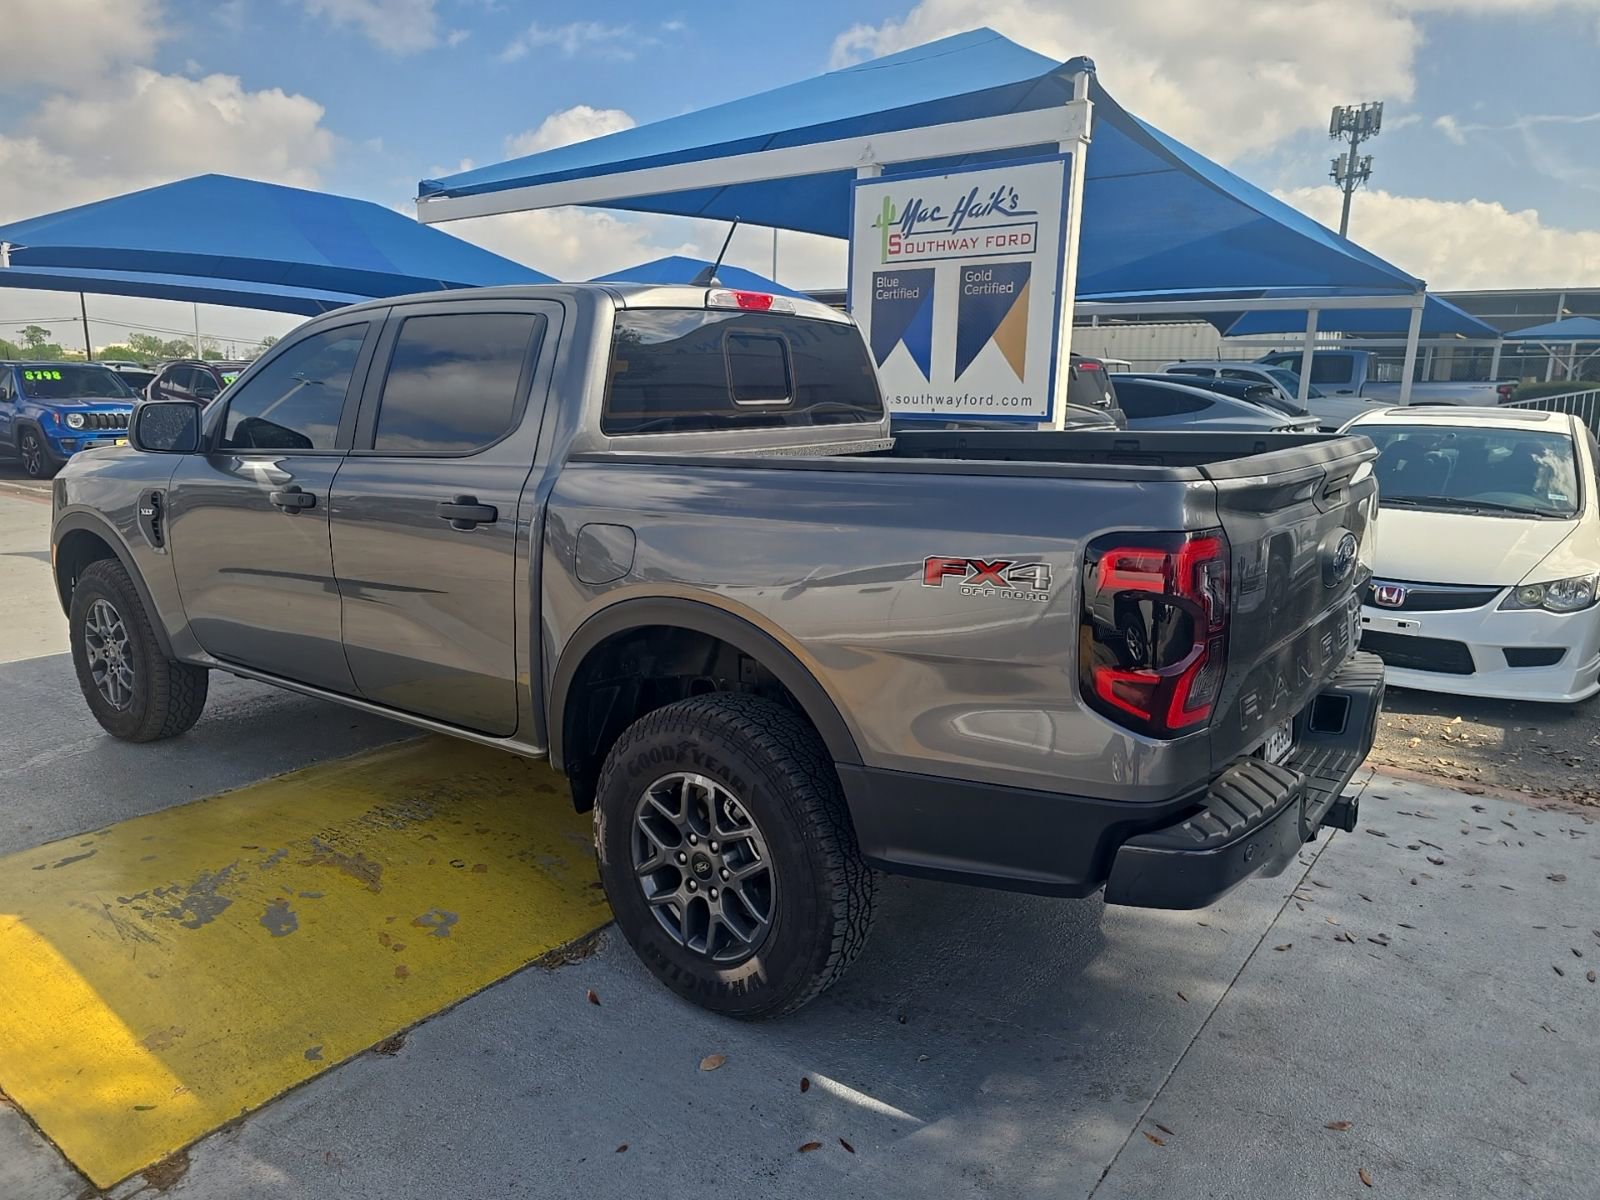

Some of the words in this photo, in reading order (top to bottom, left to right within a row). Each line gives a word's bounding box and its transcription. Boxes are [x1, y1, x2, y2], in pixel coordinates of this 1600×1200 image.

[890, 198, 949, 239] Mac
[947, 185, 1037, 235] Haik's
[888, 233, 979, 255] SOUTHWAY
[985, 233, 1032, 248] FORD
[876, 276, 900, 288] Blue
[965, 269, 992, 282] Gold
[876, 287, 920, 300] Certified
[964, 281, 1014, 296] Certified
[921, 555, 1053, 592] FX4
[960, 586, 996, 597] OFF
[1001, 589, 1050, 602] ROAD
